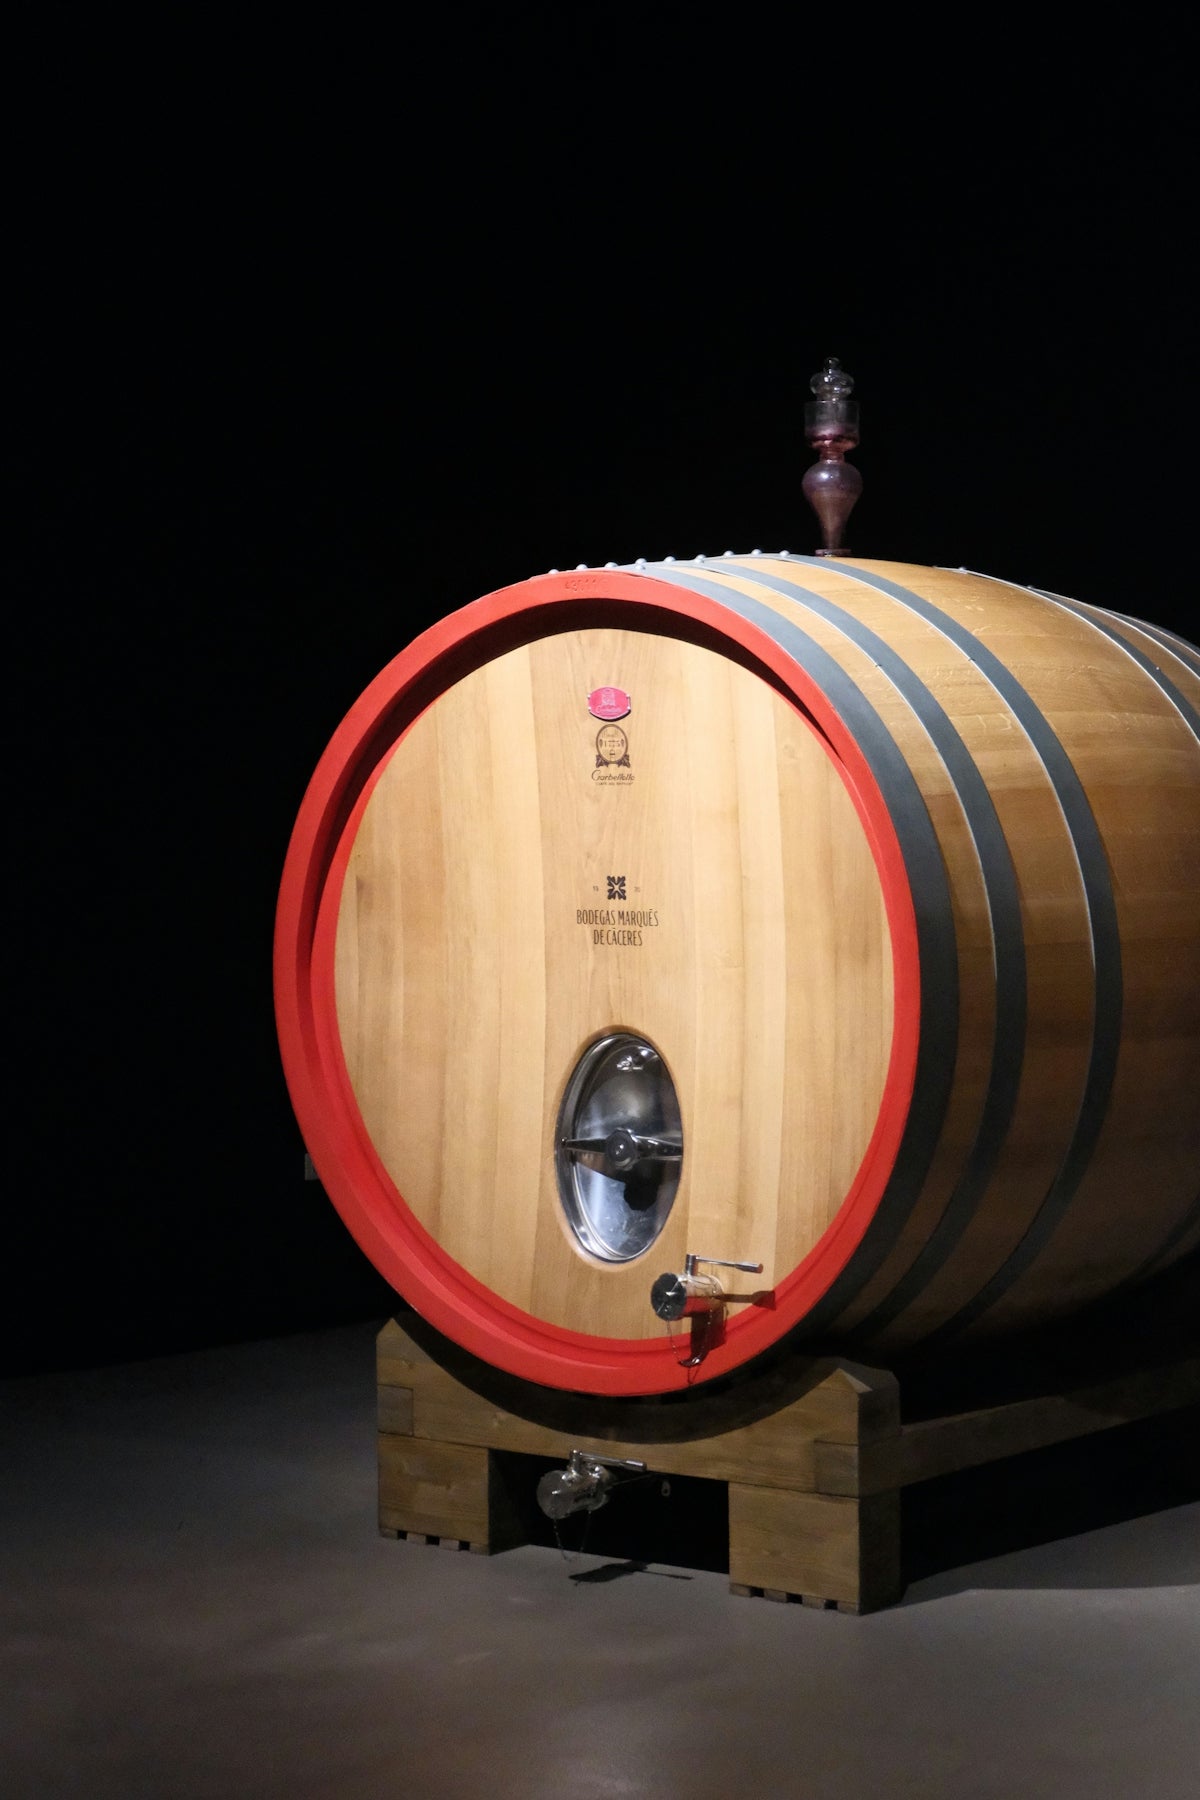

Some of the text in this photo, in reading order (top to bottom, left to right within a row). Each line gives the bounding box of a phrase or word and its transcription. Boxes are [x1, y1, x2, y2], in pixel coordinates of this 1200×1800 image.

[576, 908, 659, 927] BODEGAS MARQUÉS
[593, 927, 643, 946] DE CÁCERES
